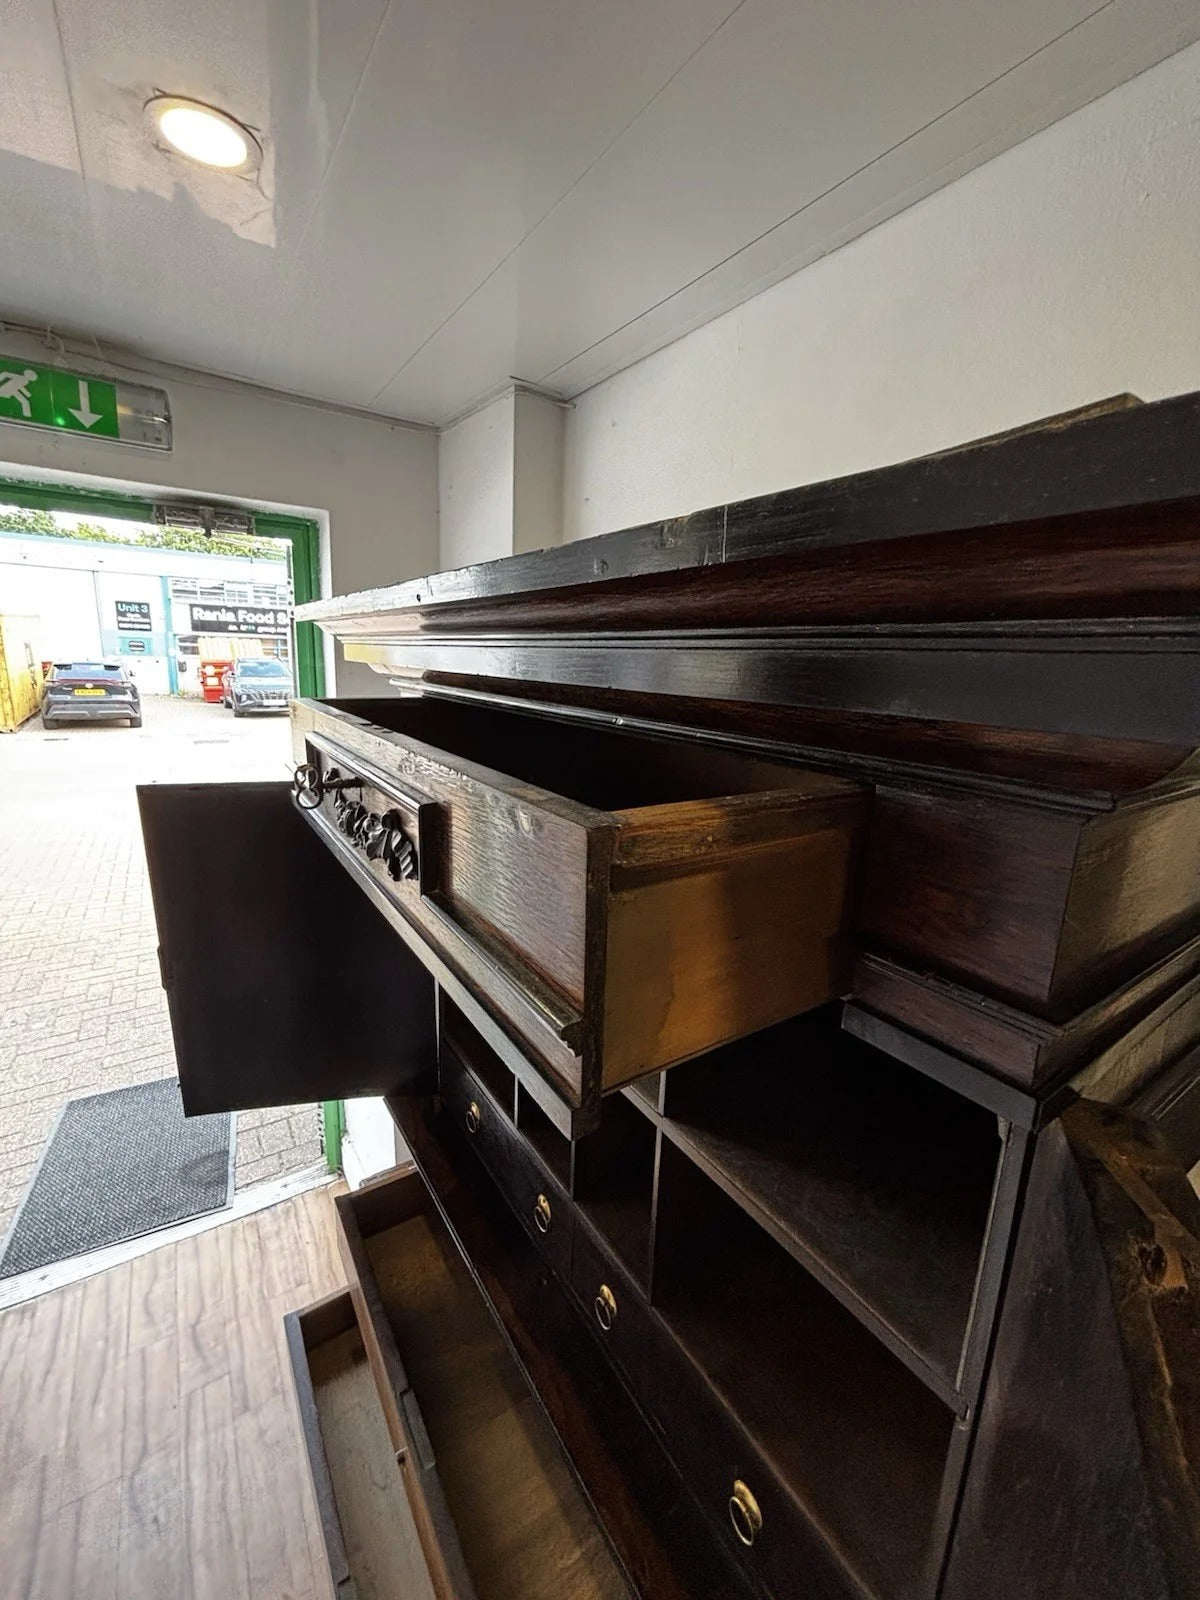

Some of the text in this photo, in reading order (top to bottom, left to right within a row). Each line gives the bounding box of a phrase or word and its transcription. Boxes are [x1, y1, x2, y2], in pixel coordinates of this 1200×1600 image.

[117, 602, 149, 614] Unit 3
[238, 609, 275, 624] Food
